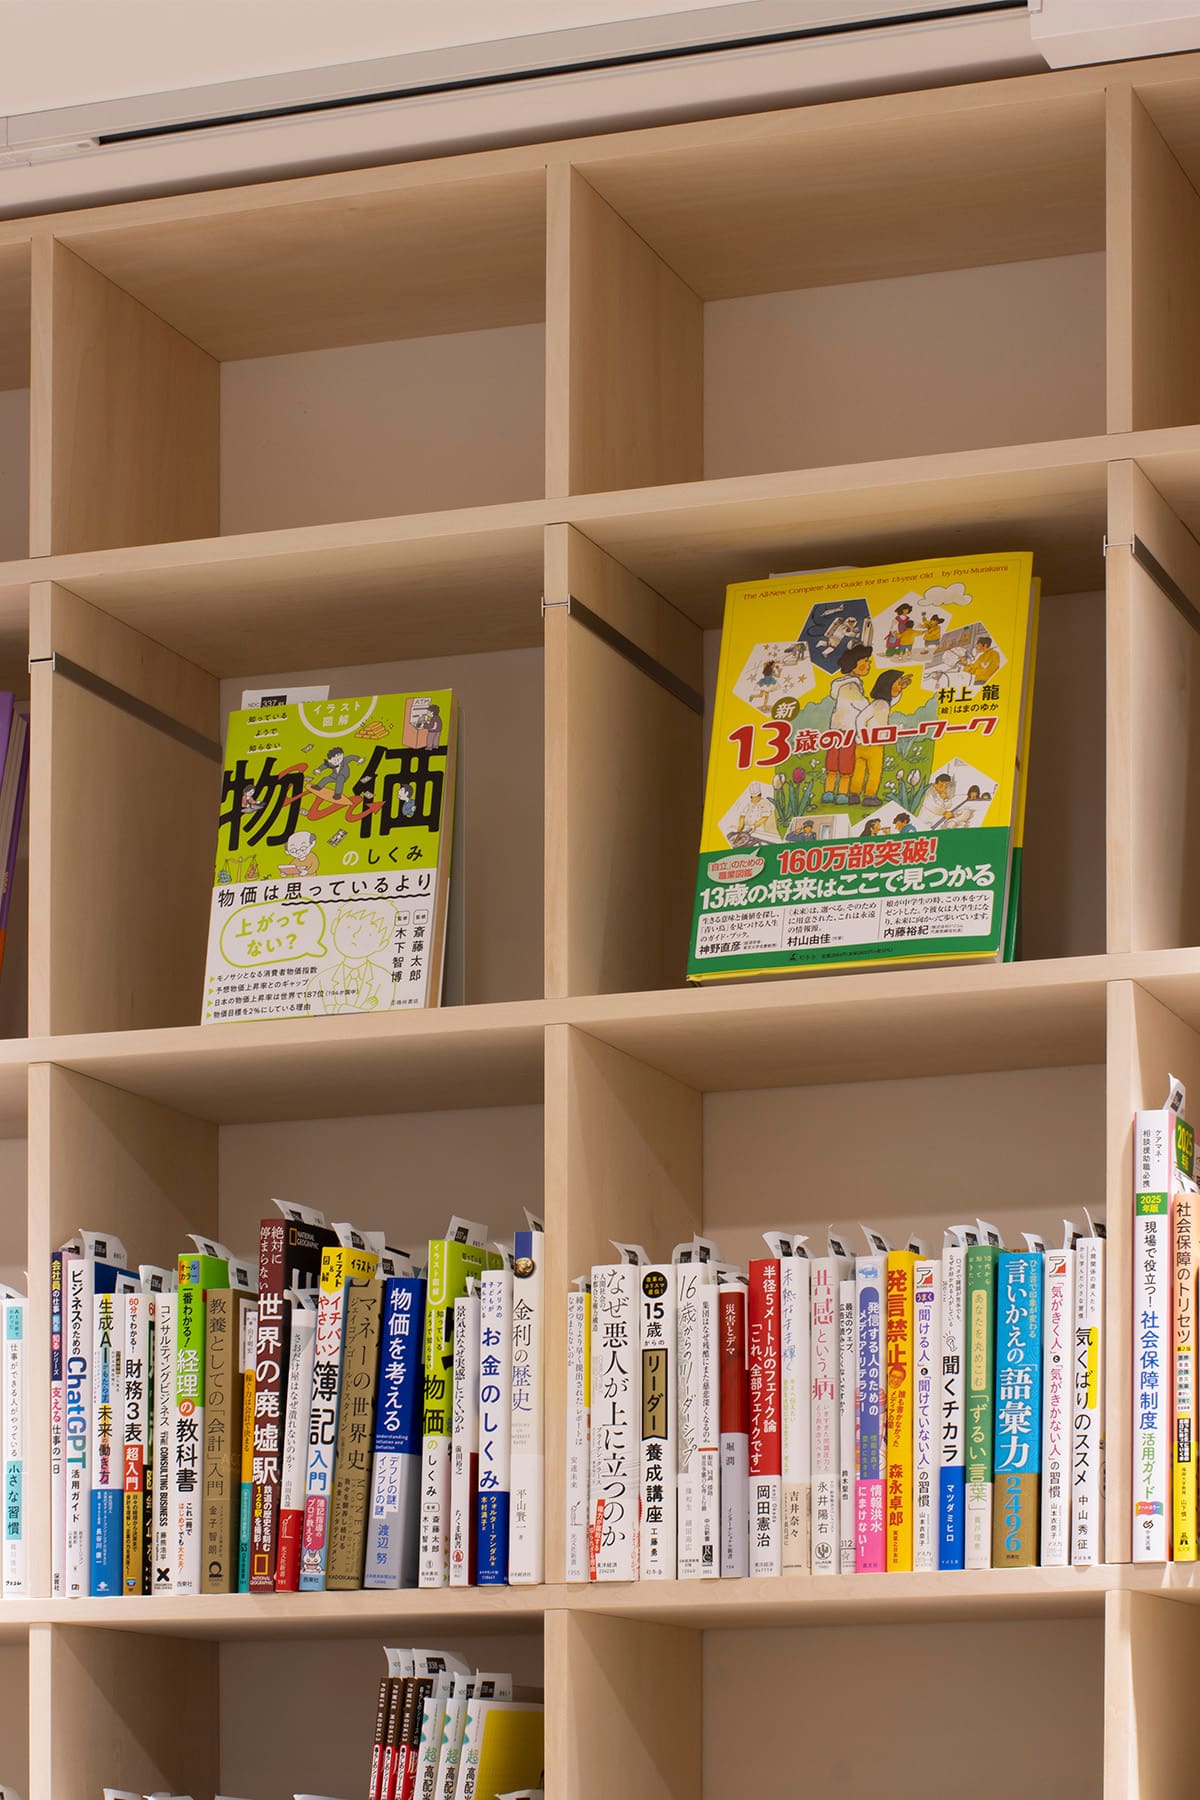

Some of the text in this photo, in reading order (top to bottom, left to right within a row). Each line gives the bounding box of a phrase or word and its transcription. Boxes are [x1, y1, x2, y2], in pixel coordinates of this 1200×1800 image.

[313, 701, 361, 715] イラスト
[774, 702, 797, 720] 新
[937, 684, 1000, 704] 村上 龍
[254, 726, 279, 737] ようで
[728, 716, 999, 770] 13歳のハローワーク
[218, 745, 448, 851] 物価
[341, 845, 423, 867] のしくみ
[699, 863, 996, 911] 13歳の将来はここで見つかる
[776, 837, 938, 874] 160万部突破!
[218, 874, 431, 908] 物価は思っているより
[235, 908, 309, 938] 上がって
[699, 941, 742, 956] 神野直彦
[787, 933, 831, 948] 村山由佳
[883, 924, 929, 939] 内藤裕紀
[215, 978, 309, 995] 予想物価上昇率とのギャップ
[217, 966, 318, 983] モノサシとなる消費者物価指数
[212, 1003, 312, 1019] 物価目標を2%にしている理由
[1140, 1195, 1162, 1204] 2025
[1142, 1204, 1159, 1213] 年版
[259, 1226, 272, 1291] 停まらない
[271, 1226, 285, 1264] 絶対に
[334, 1252, 343, 1288] イラスト
[350, 1258, 372, 1274] イラスト
[1143, 1220, 1158, 1309] 現場で役立つ!
[1175, 1201, 1192, 1344] 社会保障のトリセツ
[70, 1269, 84, 1356] ビジネスのための
[315, 1296, 330, 1357] やさしい
[328, 1295, 342, 1357] イチバン
[725, 1303, 736, 1356] 災害とデマ
[812, 1268, 836, 1401] 共感という病
[845, 1302, 854, 1354] 最近のウェブ、
[886, 1269, 908, 1369] 発言禁止
[159, 1305, 171, 1427] コンサルティングビジネス
[383, 1288, 413, 1432] 物価を考える
[454, 1305, 467, 1434] 景気はなぜ実感しにくいのか
[511, 1298, 535, 1412] 金利の歴史
[762, 1265, 778, 1433] 半径5メートルのフェイク論
[858, 1310, 868, 1413] メディア・リテラシー
[867, 1300, 880, 1416] 発信する人のための
[1139, 1310, 1160, 1431] 社会保障制度
[67, 1356, 87, 1469] ChatGPT
[124, 1359, 143, 1442] 財務3表
[175, 1287, 200, 1492] 一番わかる! 経理の教科書
[207, 1298, 227, 1497] 教養としての「会計」入門
[251, 1292, 283, 1485] 世界の廃墟駅
[346, 1298, 378, 1471] マネーの世界史
[480, 1326, 502, 1489] お金のしくみ
[602, 1269, 630, 1547] なぜ悪人が上に立つのか
[646, 1355, 665, 1431] リーダー
[750, 1322, 764, 1474] 「これ、全部フェイクです」
[917, 1303, 933, 1508] 「聞ける人」と「聞けていない人」の習慣
[942, 1355, 961, 1463] 聞くチカラ
[995, 1258, 1039, 1552] 言いかえの「語彙力」 2496
[1048, 1282, 1064, 1499] 「気がきく人」と「気がきかない人」の習慣
[1074, 1326, 1094, 1487] 気くばりのススメ
[6, 1343, 21, 1536] 仕事ができる人がやっている 小さな習慣
[51, 1386, 62, 1475] 支える仕事の一日
[308, 1360, 339, 1492] 簿記入門
[422, 1374, 446, 1497] 物価のしくみ
[968, 1395, 991, 1511] 「ずるい言葉」
[70, 1469, 81, 1524] 活用ガイド
[126, 1447, 139, 1491] 超入門
[160, 1446, 169, 1491] CONSULTING
[374, 1456, 387, 1516] インフレの謎
[386, 1456, 401, 1511] デフレの謎、
[645, 1442, 664, 1524] 養成講座
[888, 1463, 904, 1528] 森永卓郎
[1141, 1432, 1156, 1501] 活用ガイド
[159, 1491, 169, 1528] BUSINESS
[185, 1502, 193, 1537] これ一冊で
[353, 1479, 366, 1540] MONEY
[756, 1484, 771, 1548] 岡田憲治
[789, 1490, 801, 1539] 吉井奈々
[858, 1485, 868, 1557] にまけない!
[869, 1483, 883, 1533] 情報洪水
[945, 1484, 956, 1544] マツダミヒロ
[1077, 1495, 1089, 1551] 中山秀征
[376, 1524, 390, 1565] 渡辺努
